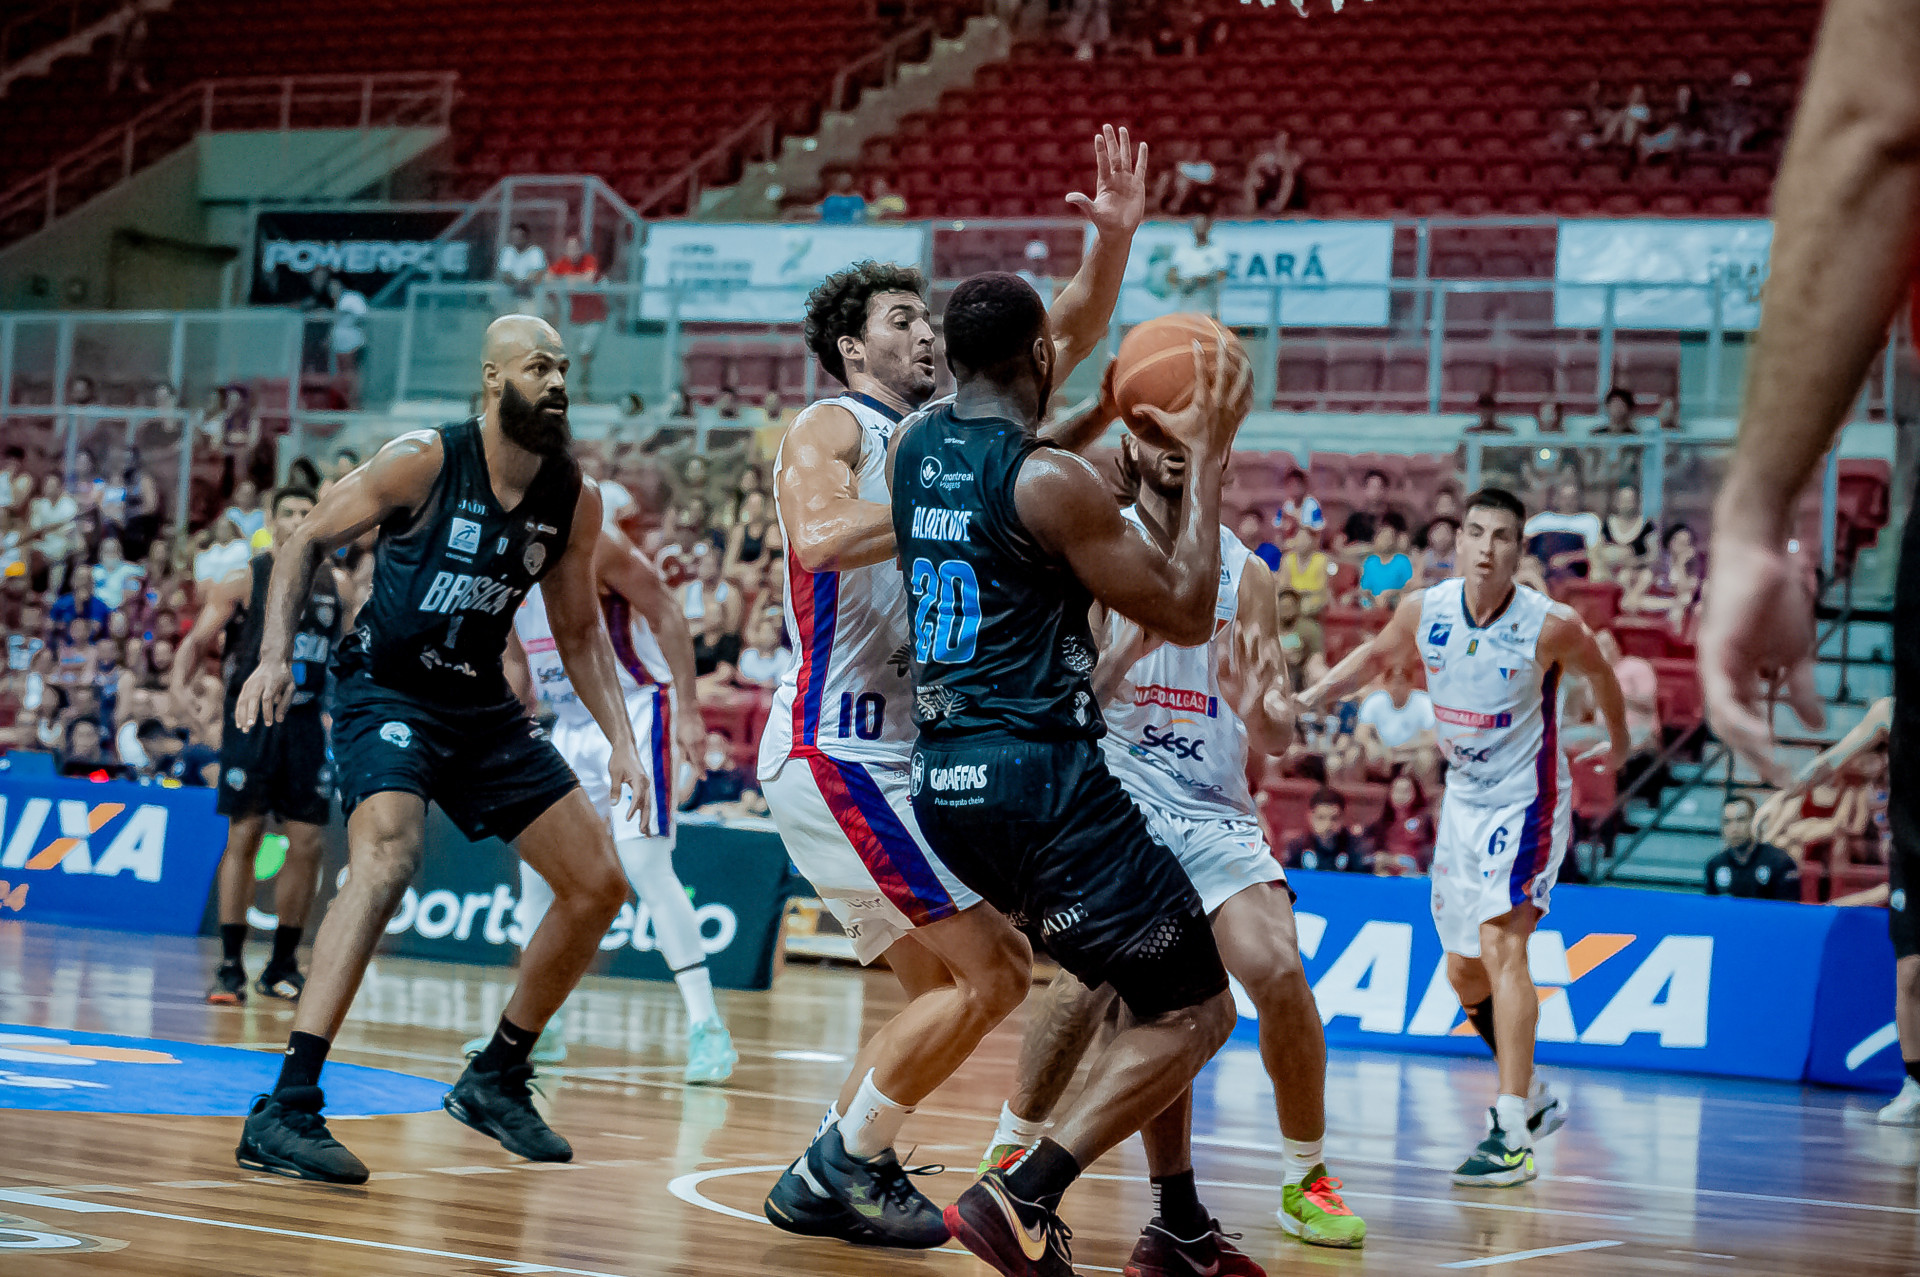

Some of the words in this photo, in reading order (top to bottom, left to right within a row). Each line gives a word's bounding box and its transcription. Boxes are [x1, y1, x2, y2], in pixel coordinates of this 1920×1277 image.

[942, 471, 974, 481] montreal
[911, 557, 982, 664] 20
[838, 691, 887, 741] 10
[1488, 826, 1508, 856] 6
